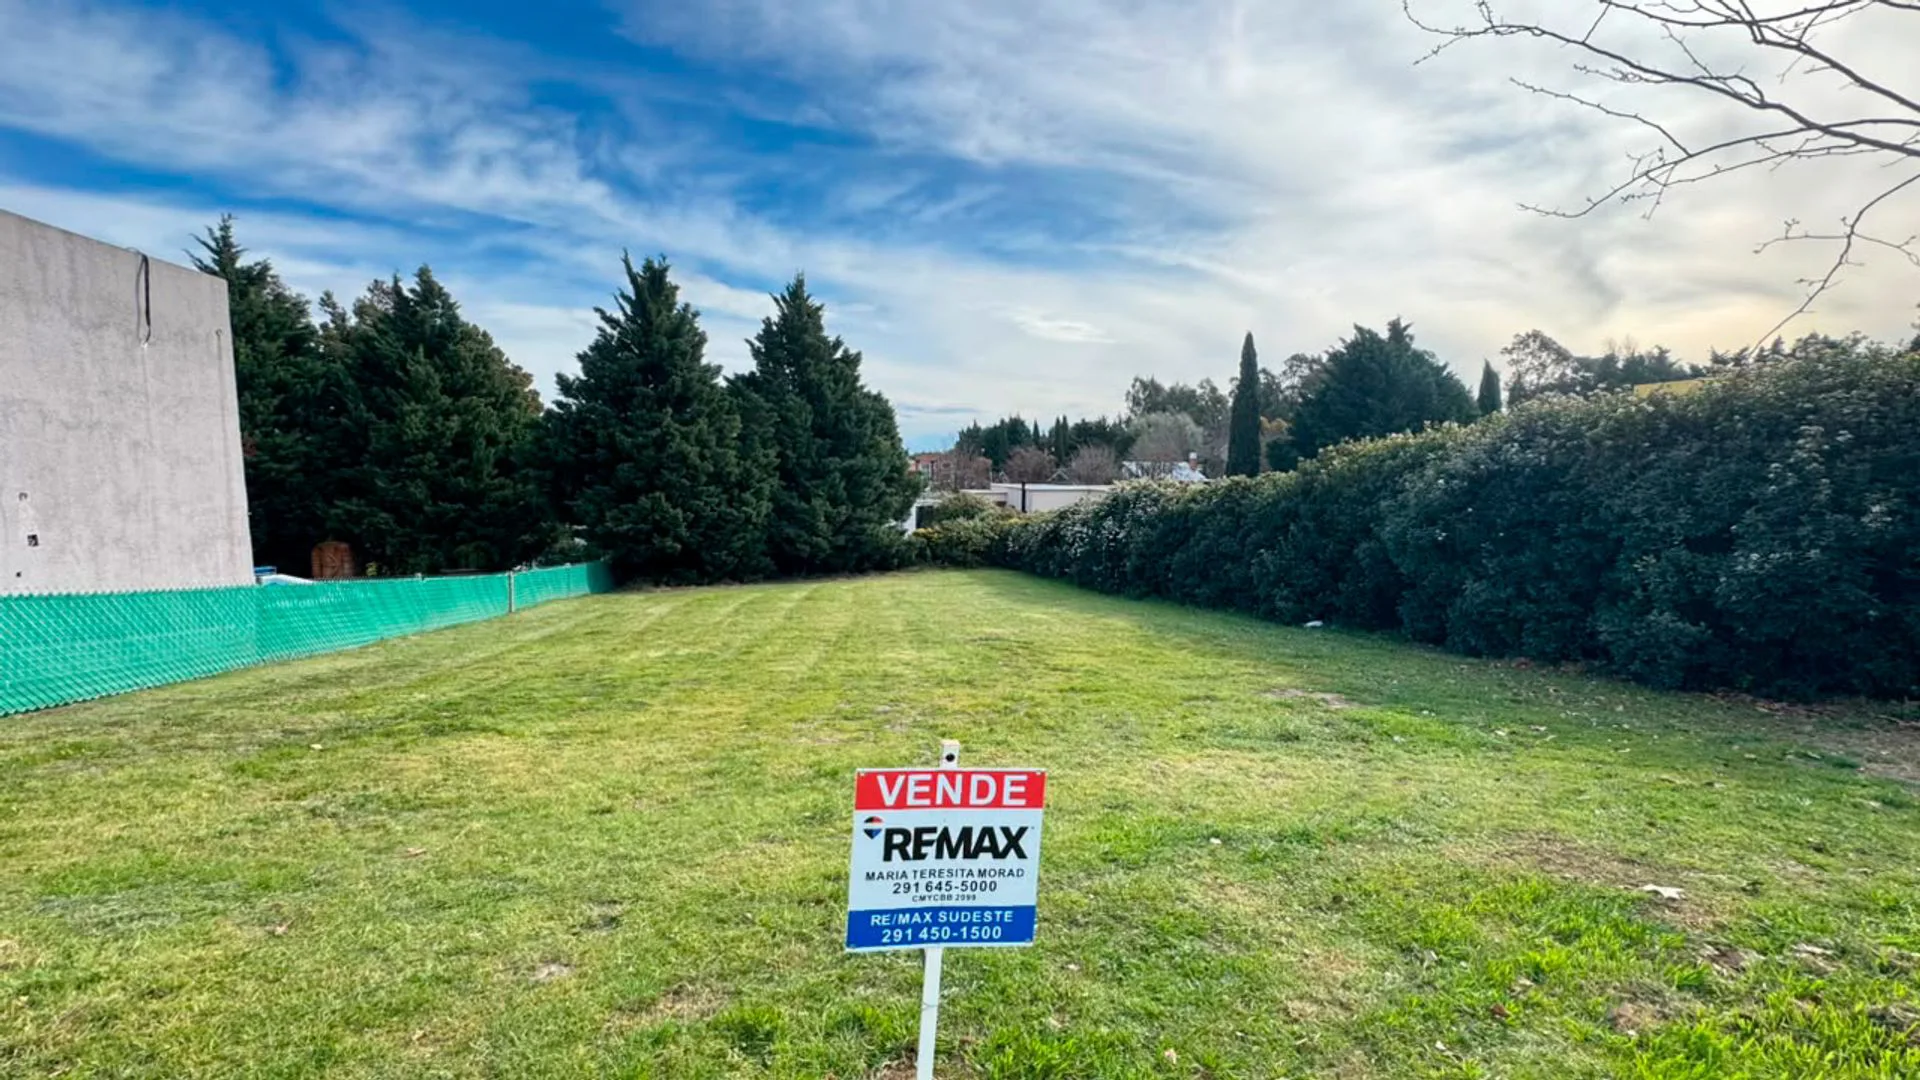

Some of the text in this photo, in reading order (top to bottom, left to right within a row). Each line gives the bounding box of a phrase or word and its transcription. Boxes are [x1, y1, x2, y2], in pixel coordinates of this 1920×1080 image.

[877, 774, 1028, 806] VENDE
[865, 868, 1025, 881] MARIA TERESITA MORAD
[892, 881, 997, 893] 291 645-5000
[871, 911, 1014, 926] RE/MAX SUDESTE
[882, 926, 1002, 942] 291 450-1500
